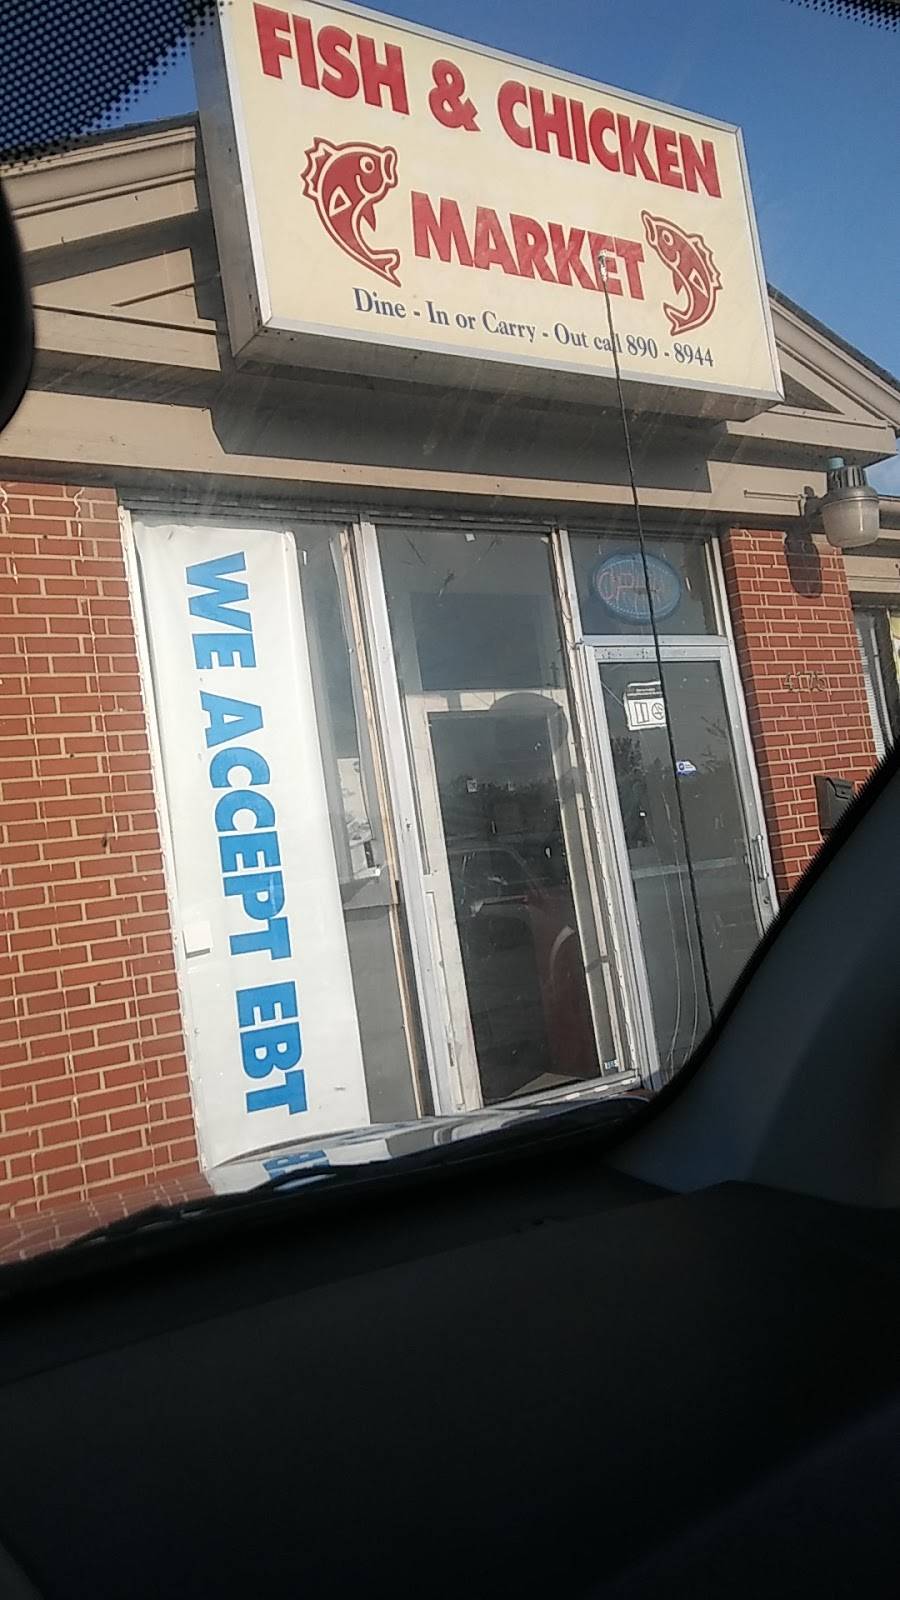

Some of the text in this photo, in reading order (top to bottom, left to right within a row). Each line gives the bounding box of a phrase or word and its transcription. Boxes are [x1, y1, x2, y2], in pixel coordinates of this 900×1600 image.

[253, 3, 721, 198] FISH & CHICKEN
[410, 191, 645, 300] MARKET
[352, 287, 407, 318] Dine
[425, 300, 450, 326] In
[455, 313, 476, 330] or
[482, 310, 536, 343] Carry
[554, 323, 589, 348] Out
[626, 334, 658, 359] 890
[674, 342, 714, 367] 8944
[186, 551, 256, 670] WE
[199, 690, 292, 960] ACCEPT
[236, 980, 308, 1116] EBT
